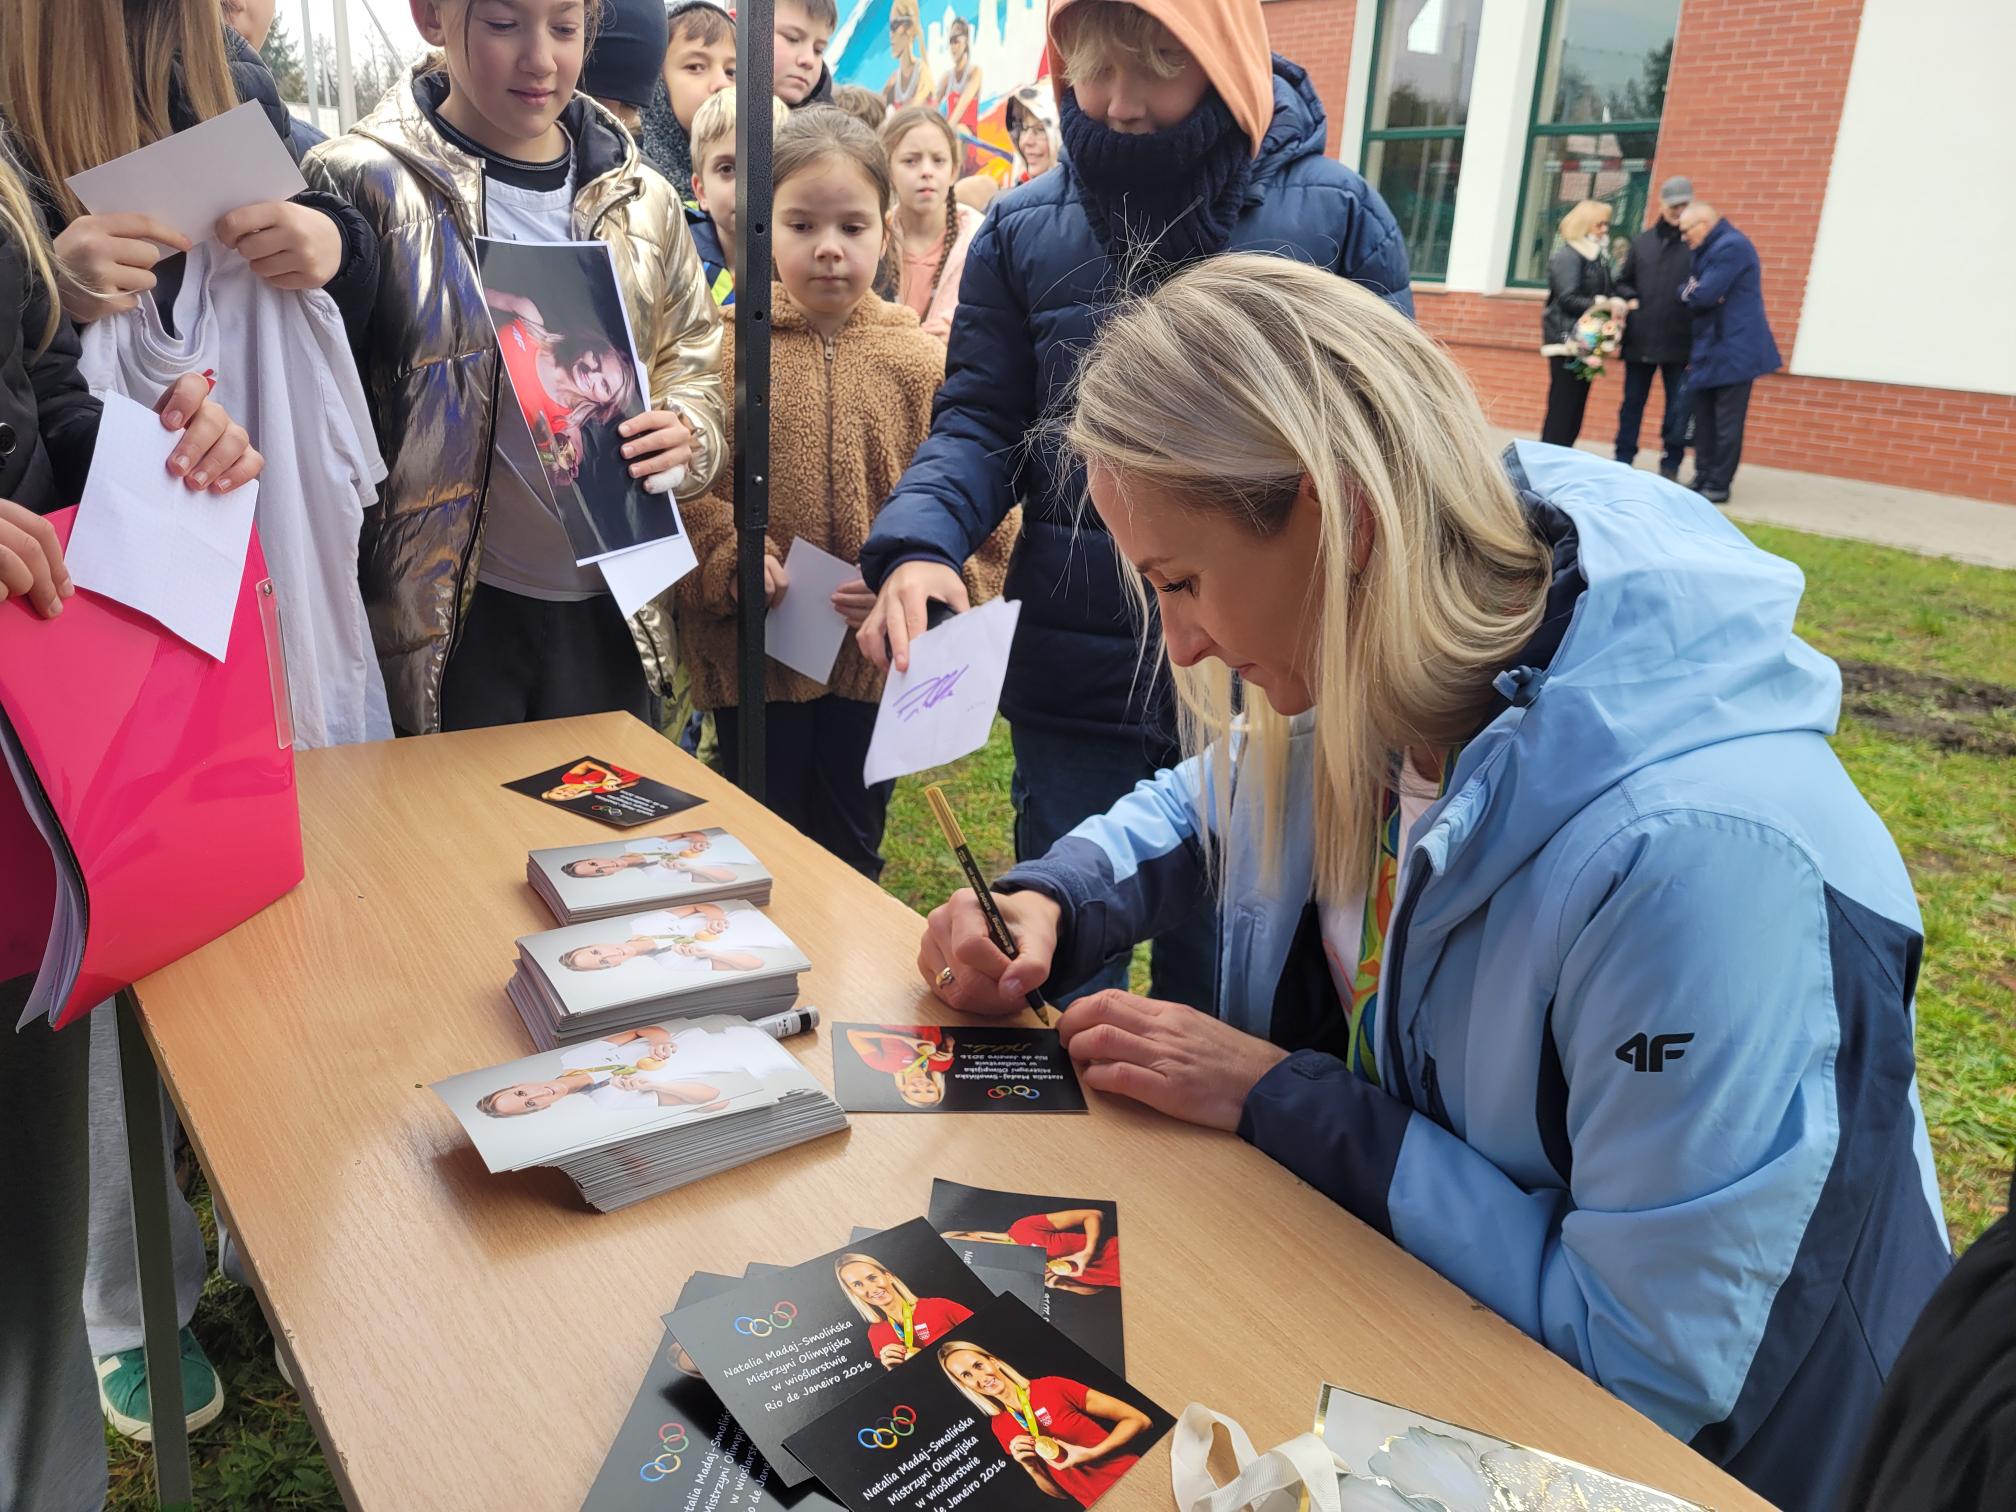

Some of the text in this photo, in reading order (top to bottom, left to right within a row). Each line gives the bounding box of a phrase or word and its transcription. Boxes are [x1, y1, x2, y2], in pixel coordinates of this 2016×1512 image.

[1615, 1032, 1695, 1072] 4F
[723, 1319, 853, 1378] Natalia Madaj-Smolińska
[746, 1336, 851, 1386] Mistrzyni Olimpijska
[771, 1354, 848, 1392] w wioślarstwie
[764, 1360, 873, 1412] Rio de Janeiro 2016
[862, 1416, 975, 1501] Natalia Madaj-Smolińska
[887, 1435, 979, 1505] Mistrzyni Olimpijska
[915, 1455, 981, 1509] w wioślarstwie
[729, 1494, 740, 1504] w
[748, 1489, 762, 1504] de
[948, 1480, 980, 1509] Janeiro
[979, 1459, 1007, 1483] 2016
